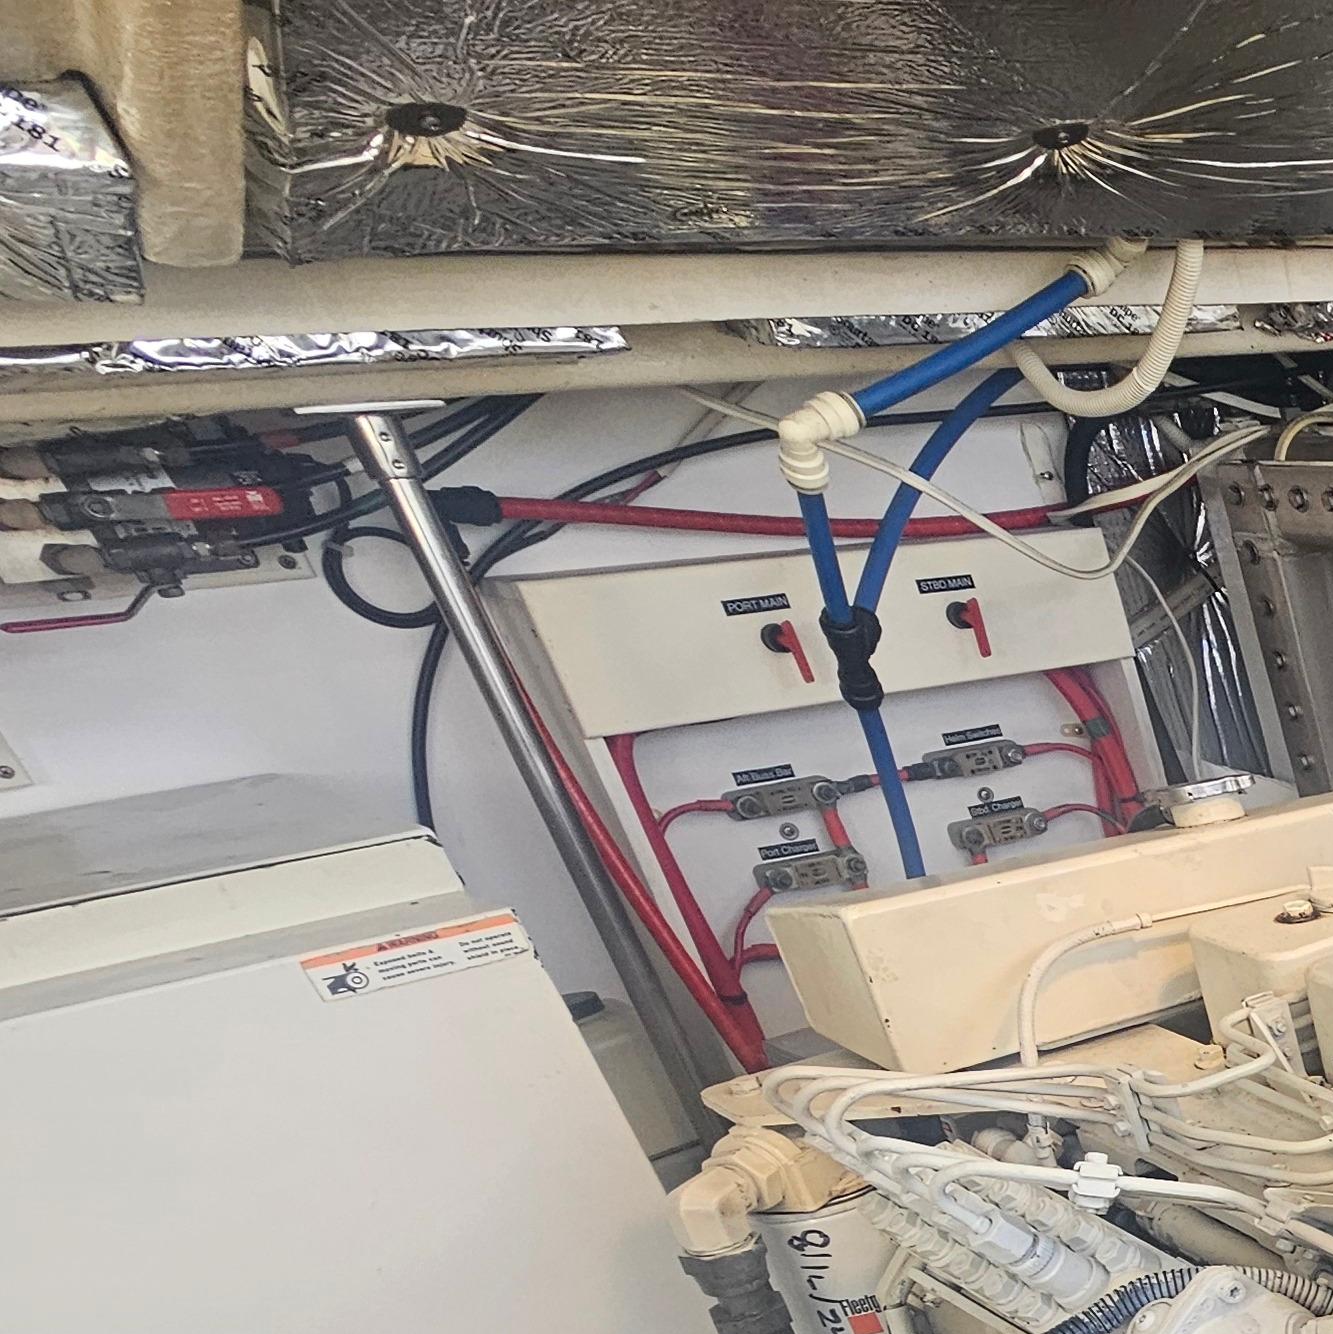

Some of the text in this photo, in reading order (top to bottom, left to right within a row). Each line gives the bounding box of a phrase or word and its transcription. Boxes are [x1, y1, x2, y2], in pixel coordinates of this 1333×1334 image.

[920, 577, 972, 592] STBD MAIN
[727, 596, 788, 614] PORT MAIN
